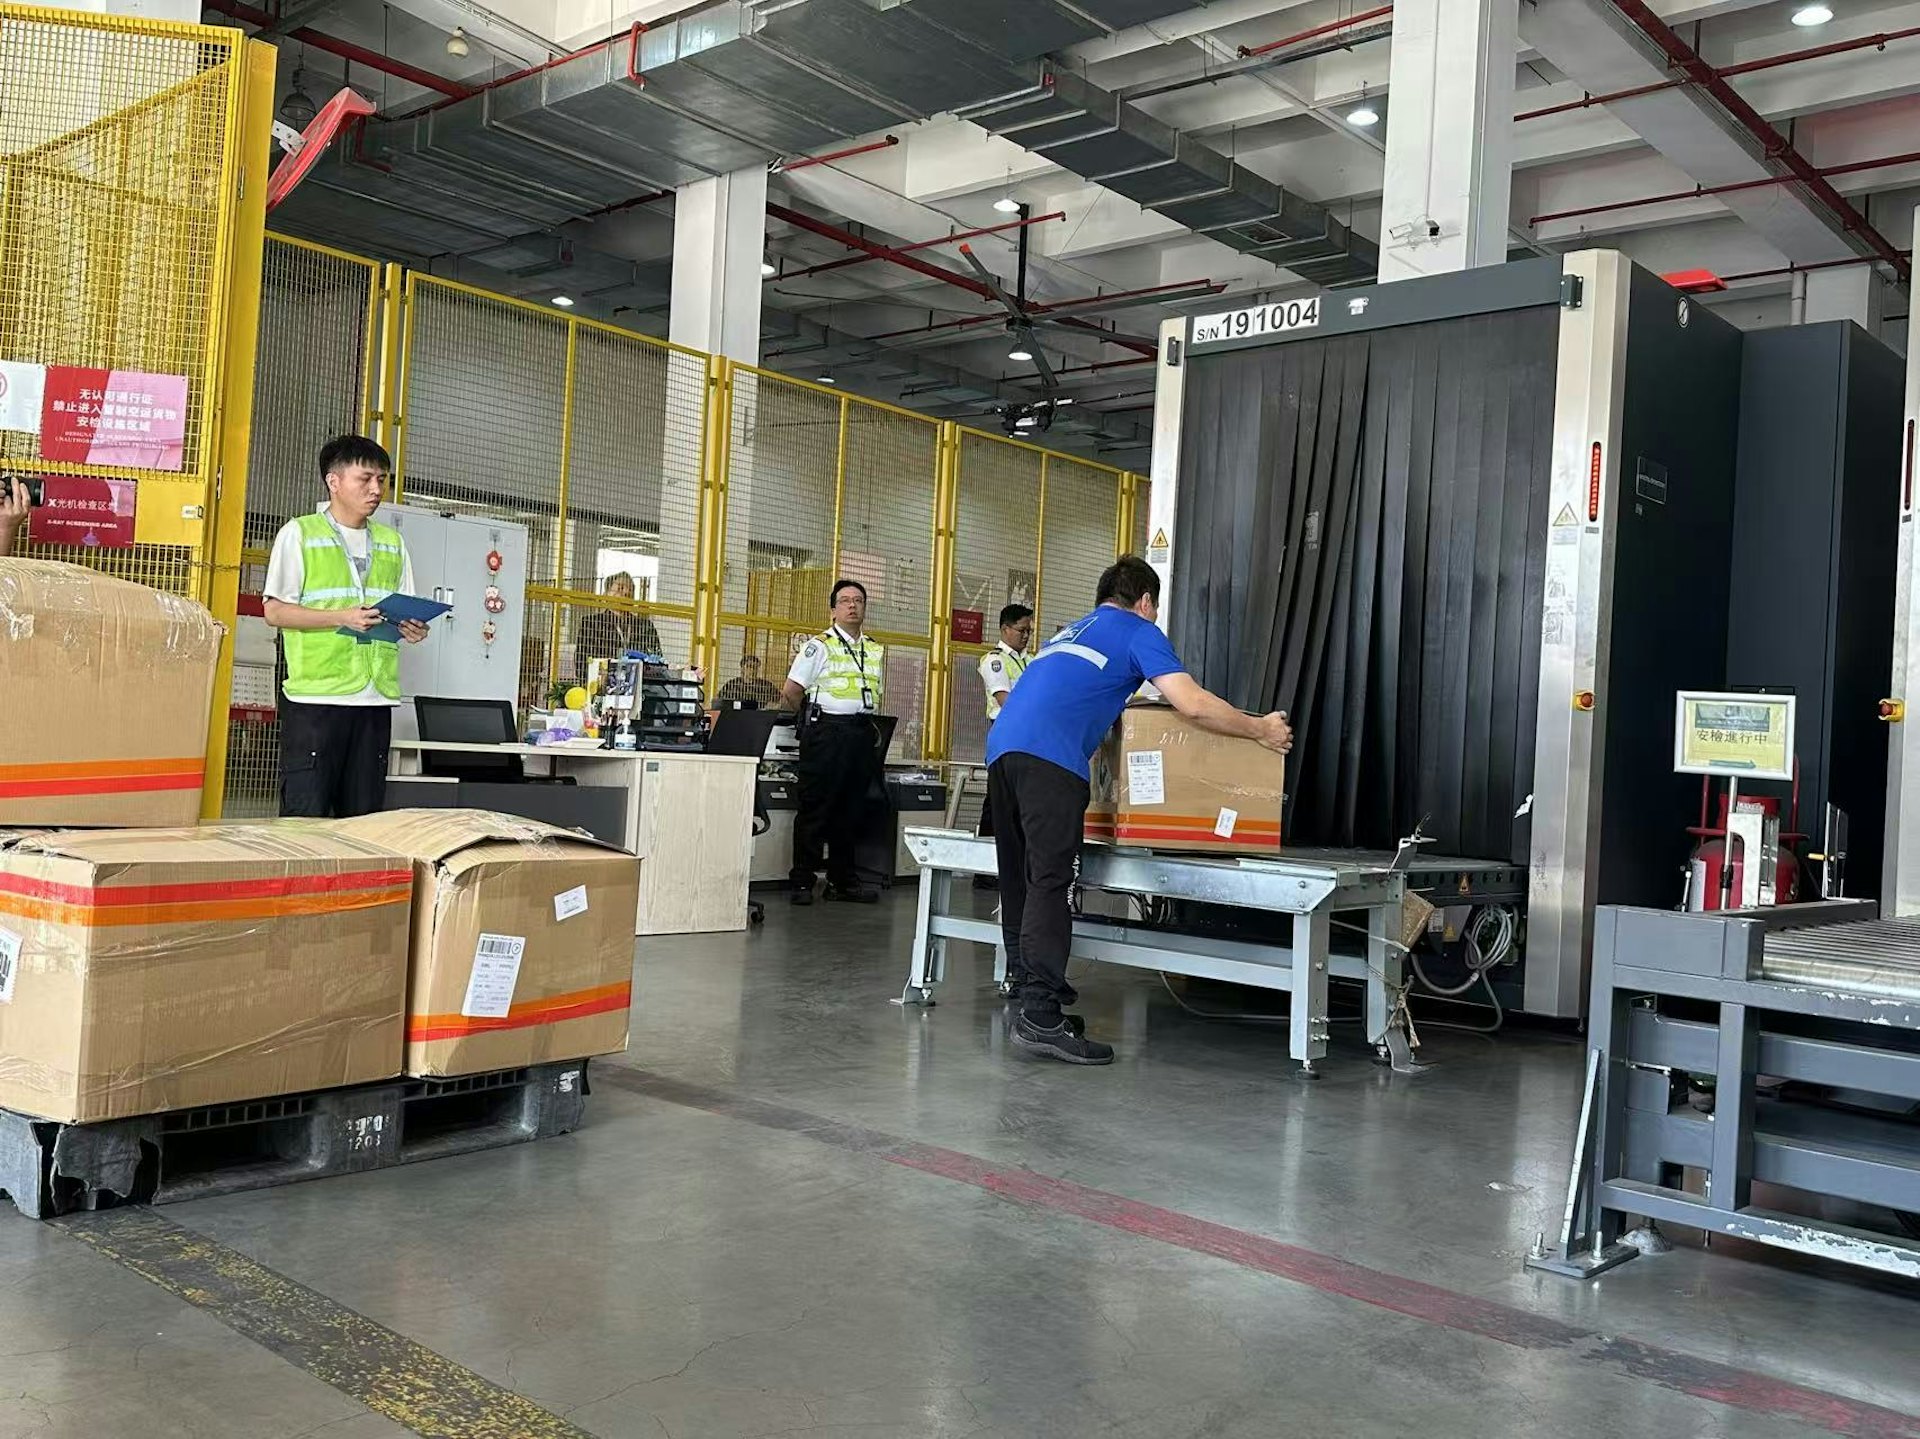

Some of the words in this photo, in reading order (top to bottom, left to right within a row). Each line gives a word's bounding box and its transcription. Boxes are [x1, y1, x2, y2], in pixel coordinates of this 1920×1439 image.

[1197, 327, 1219, 341] S/N
[1222, 298, 1318, 337] 191004
[66, 520, 101, 528] SCREENING
